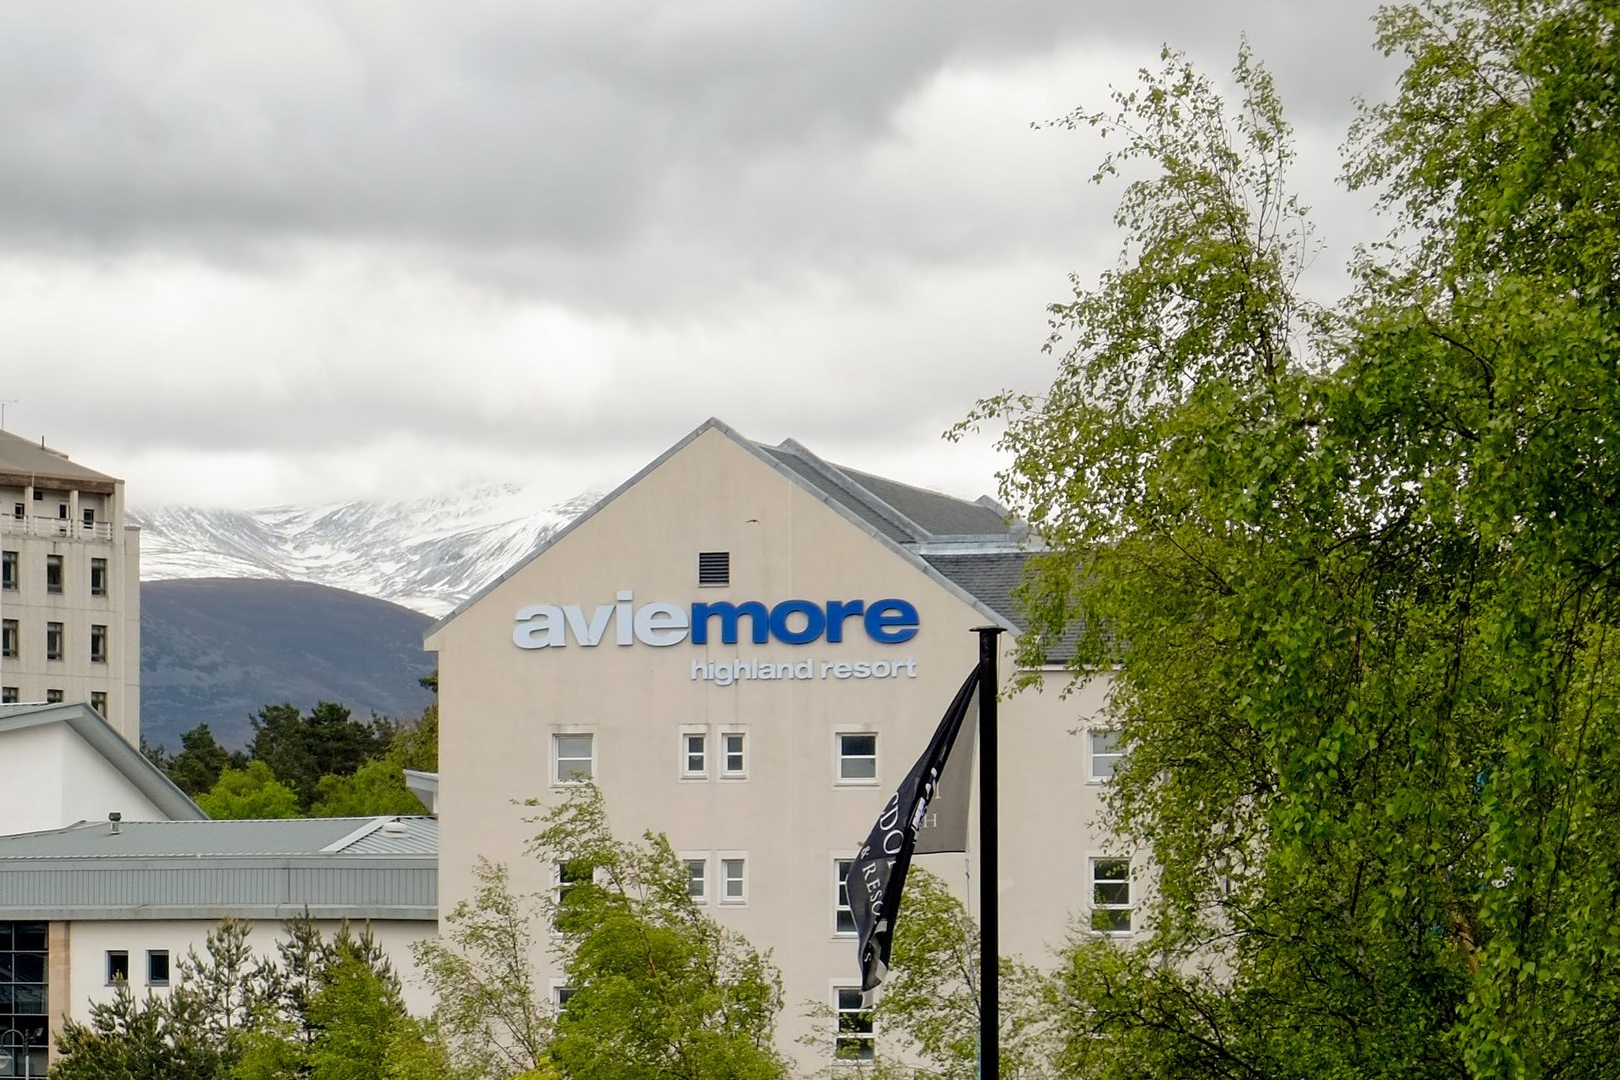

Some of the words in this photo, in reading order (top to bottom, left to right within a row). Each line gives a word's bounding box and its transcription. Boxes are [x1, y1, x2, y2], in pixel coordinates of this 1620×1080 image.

[512, 590, 920, 650] aviemore
[690, 657, 813, 686] highland
[821, 657, 917, 681] resort
